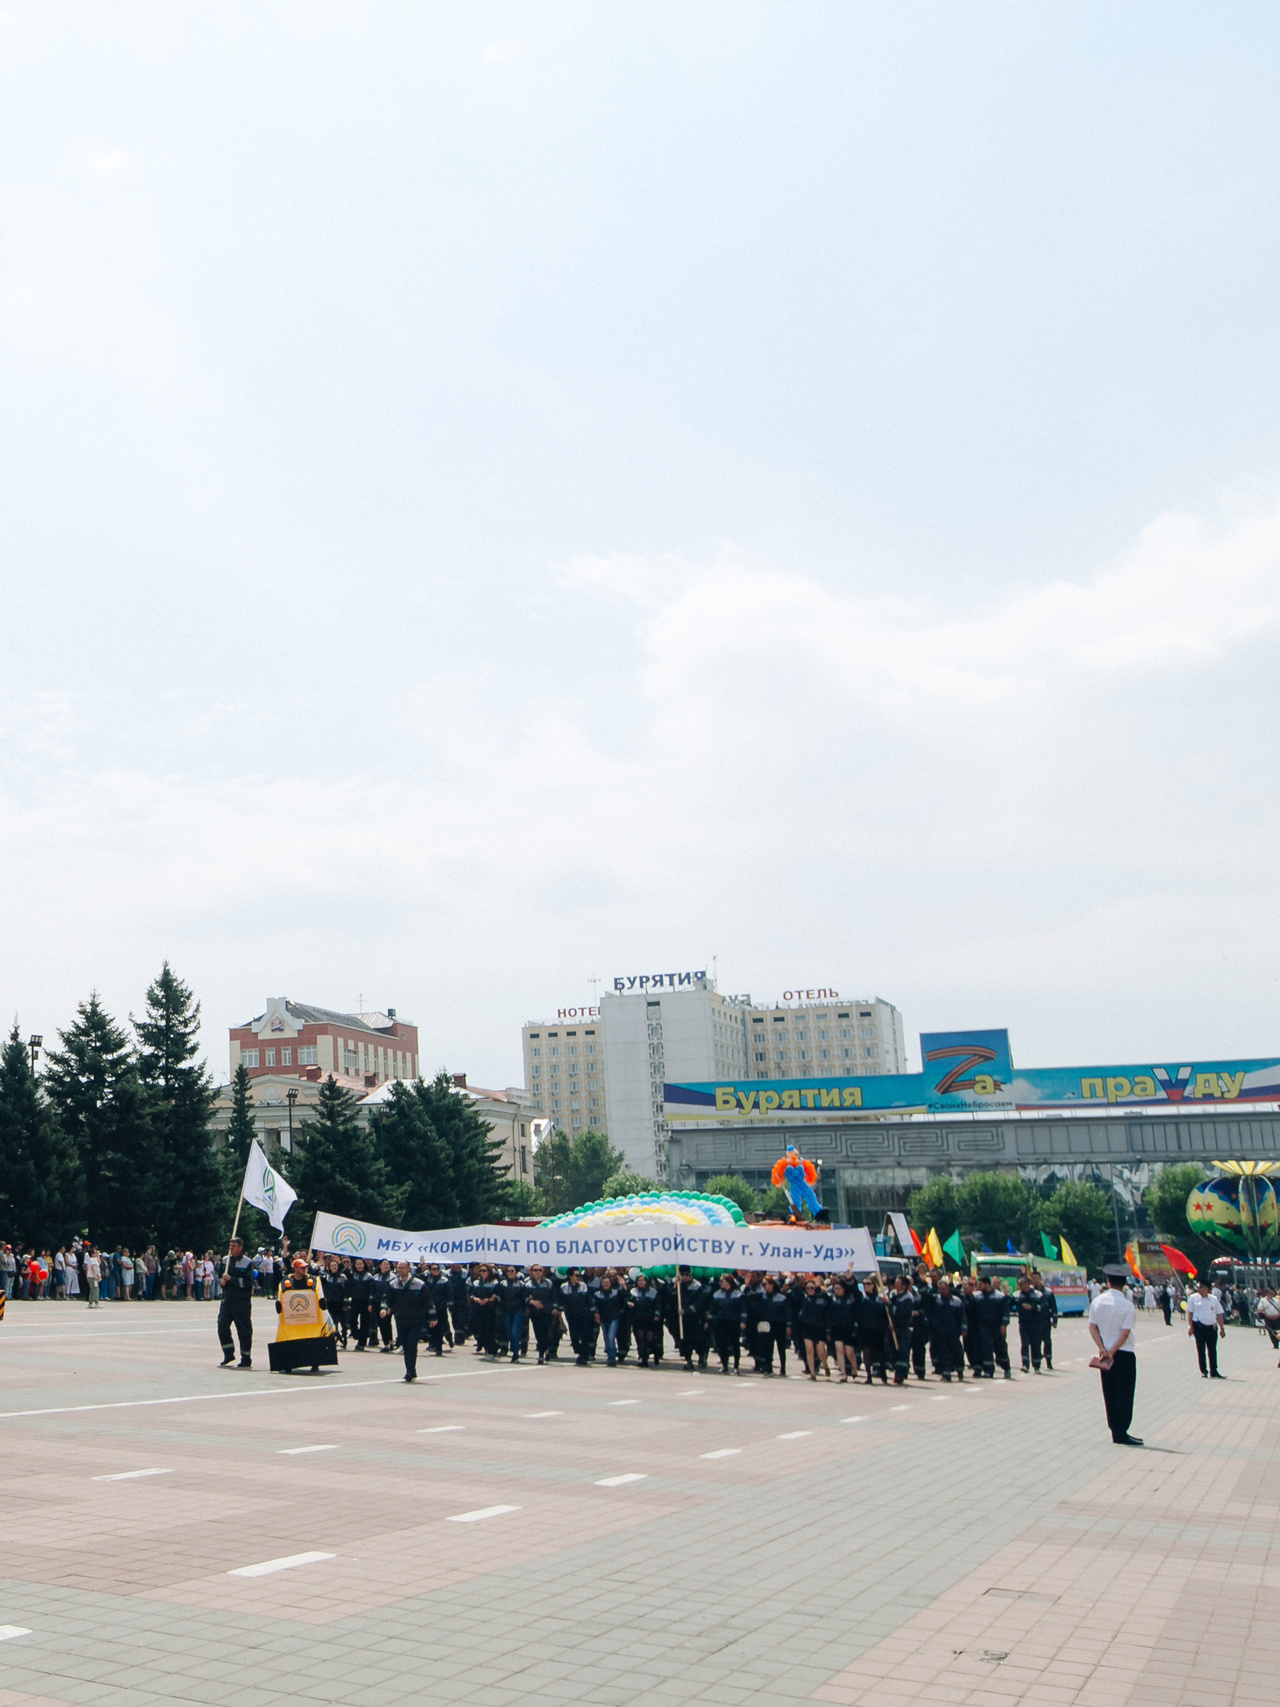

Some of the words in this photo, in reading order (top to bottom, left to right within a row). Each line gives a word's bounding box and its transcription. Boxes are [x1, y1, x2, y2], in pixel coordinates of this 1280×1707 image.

[613, 970, 707, 991] БУРЯТИЯ
[782, 988, 839, 1001] ОТЕЛЬ
[557, 1006, 601, 1019] HOTE
[714, 1086, 864, 1115] Бурятия
[927, 1101, 1013, 1110] #СвоихНеБросаем
[376, 1238, 414, 1252] МБУ
[417, 1237, 521, 1254] «КОМБИНАТ
[525, 1239, 551, 1255] ПО
[556, 1233, 736, 1255] БЛАГОУСТРОЙСТВУ
[741, 1243, 754, 1256] г.
[759, 1242, 856, 1261] Улан-Удэ»
